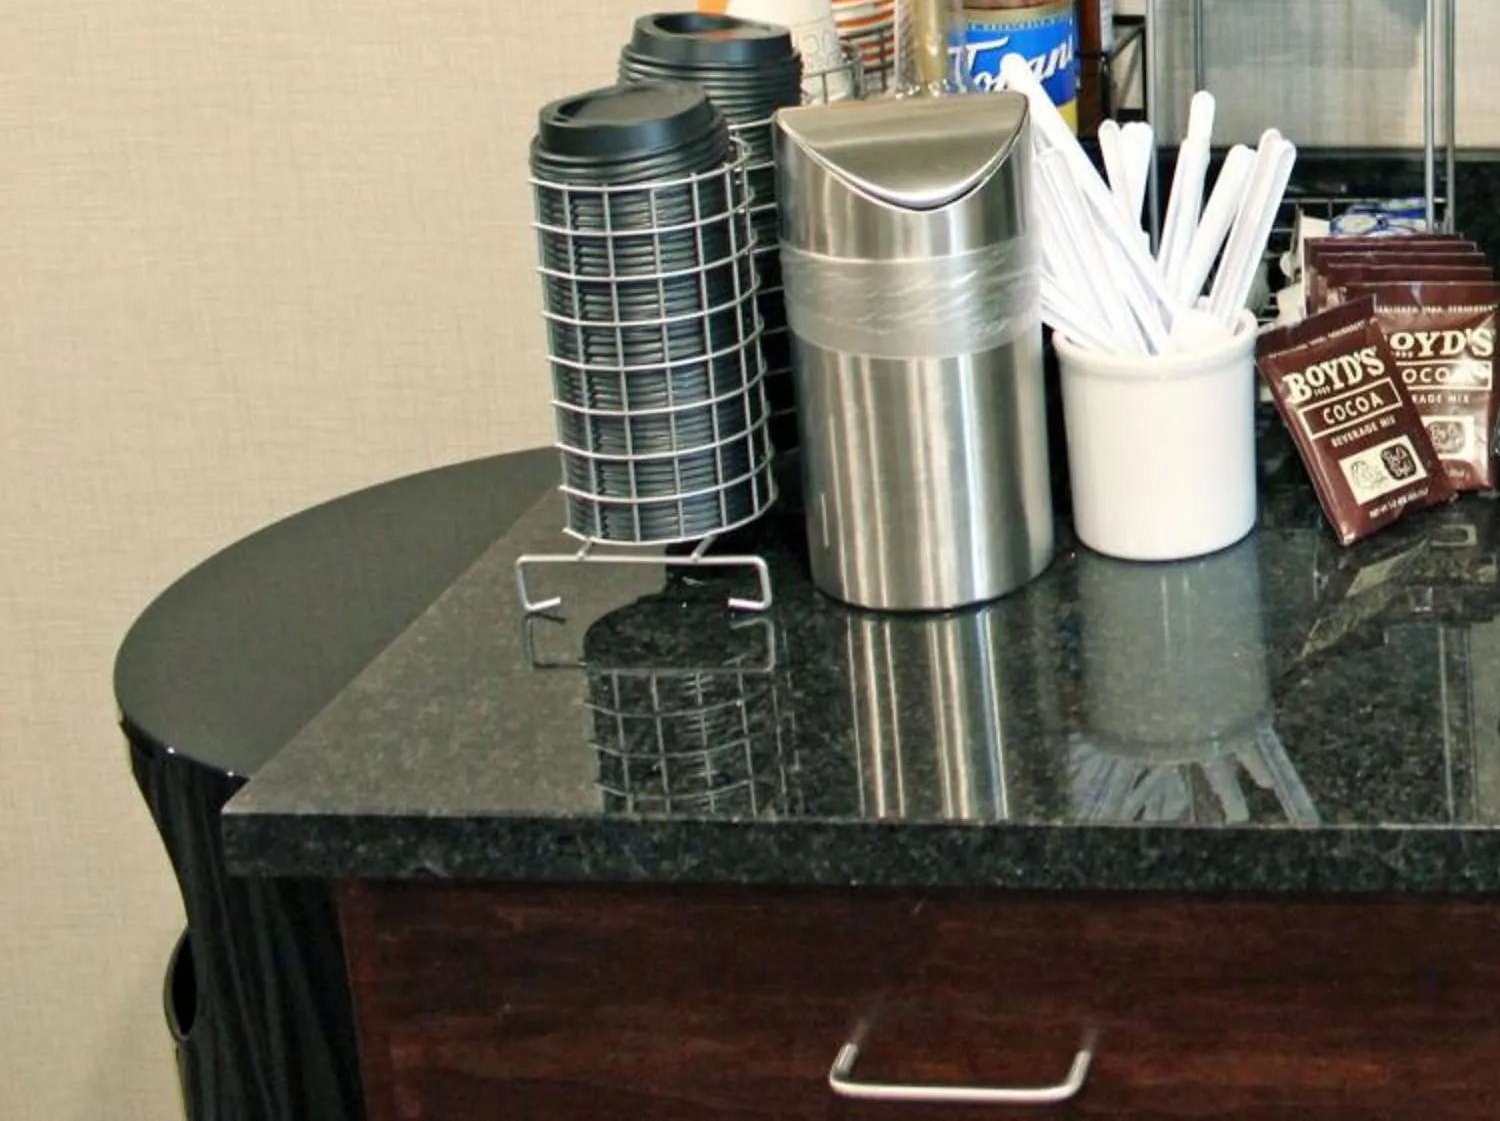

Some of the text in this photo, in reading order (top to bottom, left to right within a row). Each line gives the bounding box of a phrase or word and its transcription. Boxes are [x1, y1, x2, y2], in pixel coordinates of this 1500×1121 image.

[1389, 328, 1494, 358] OYD'S
[1281, 346, 1386, 405] BOYD'S
[1402, 368, 1450, 384] OCO
[1322, 391, 1385, 425] COCOA
